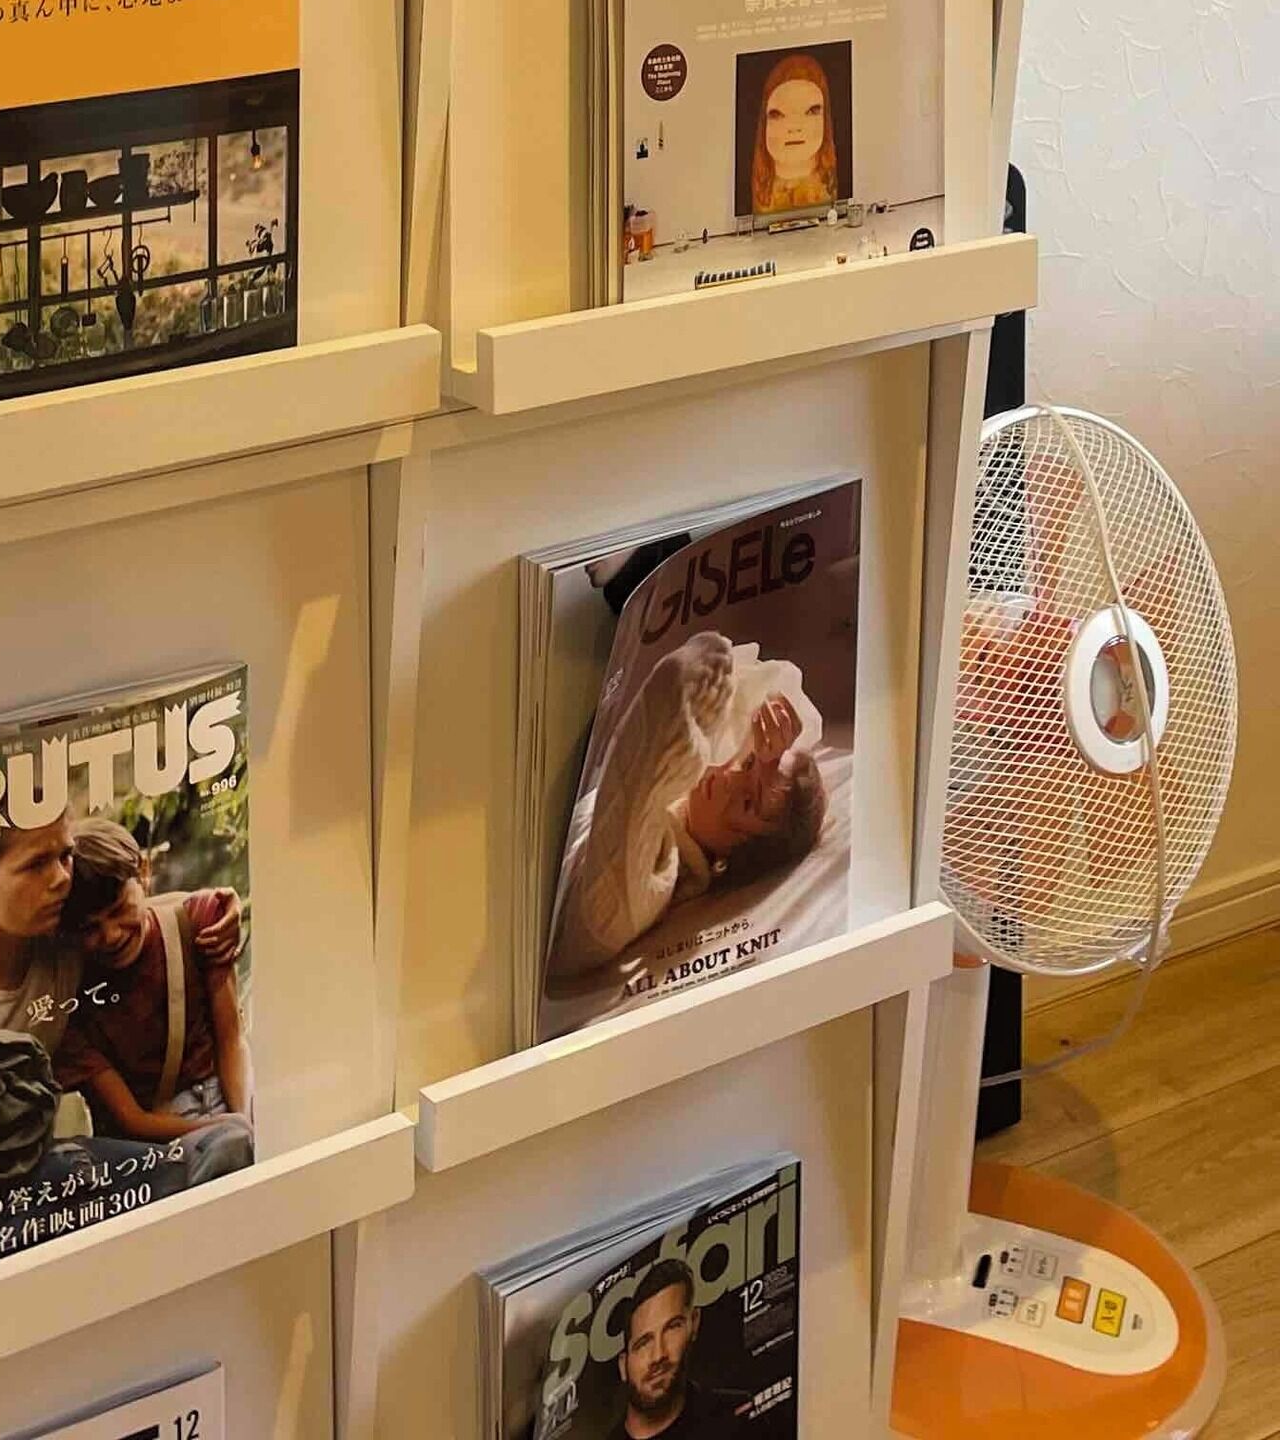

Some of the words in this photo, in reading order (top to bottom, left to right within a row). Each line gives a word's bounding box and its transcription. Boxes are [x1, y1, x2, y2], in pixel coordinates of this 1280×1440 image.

[664, 947, 730, 985] ABOUT
[736, 928, 782, 960] KNIT
[26, 981, 120, 1024] 愛って。
[740, 1279, 763, 1312] 12
[174, 1409, 199, 1440] 12
